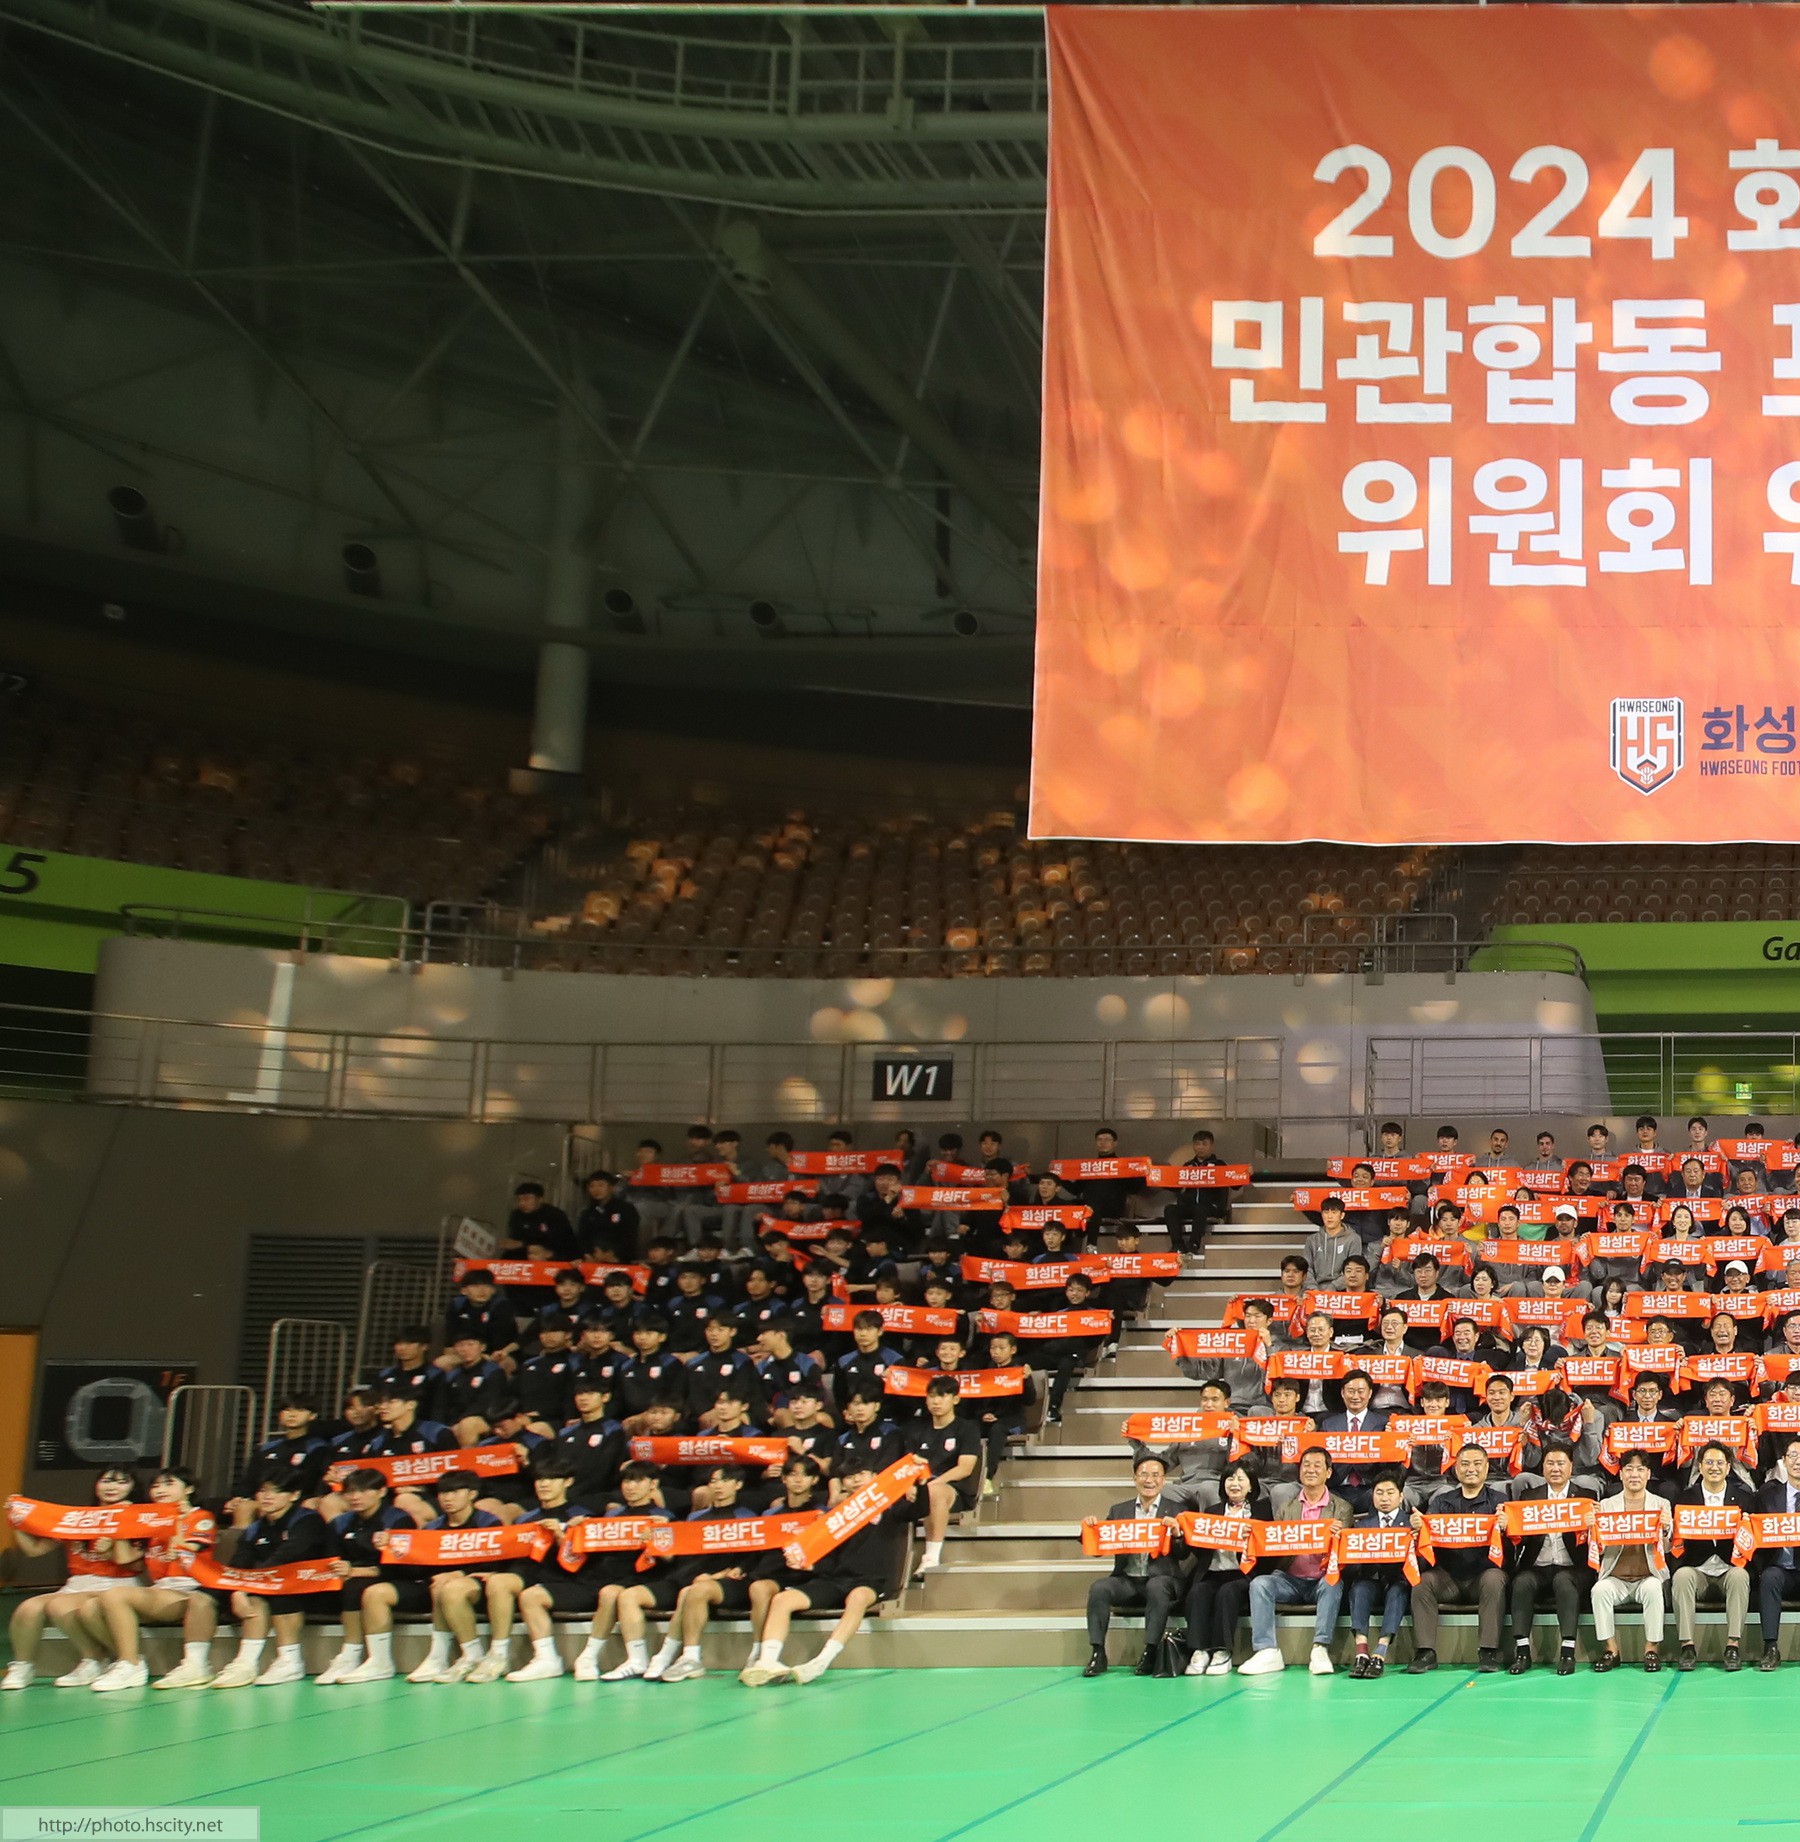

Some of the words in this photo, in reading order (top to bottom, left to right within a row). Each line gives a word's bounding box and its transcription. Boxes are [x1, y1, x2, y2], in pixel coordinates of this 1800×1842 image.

[1312, 146, 1688, 259] 2024
[1210, 297, 1722, 425] 민관합동
[1338, 456, 1713, 587] 위원회
[1619, 700, 1675, 713] HWASEONG
[1701, 760, 1767, 776] HWASEONG
[886, 1065, 939, 1096] W1
[825, 1155, 866, 1167] 화성FC
[1080, 1161, 1118, 1172] 화성FC
[1179, 1169, 1215, 1181] 화성FC
[932, 1190, 970, 1202] 화성FC
[1456, 1187, 1496, 1199] 화성FC
[1021, 1210, 1062, 1222] 화성FC
[1599, 1235, 1640, 1248] 화성FC
[1713, 1240, 1755, 1252] 화성FC
[1409, 1244, 1451, 1258] 화성FC
[1519, 1244, 1560, 1257] 화성FC
[1658, 1244, 1699, 1258] 화성FC
[1026, 1265, 1070, 1280] 화성FC
[1315, 1295, 1361, 1309] 화성FC
[1519, 1301, 1562, 1314] 화성FC
[1642, 1296, 1687, 1308] 화성FC
[1019, 1315, 1067, 1328] 화성FC
[1197, 1333, 1245, 1348] 화성FC
[1284, 1354, 1333, 1368] 화성FC
[1628, 1348, 1676, 1363] 화성FC
[1358, 1359, 1405, 1373] 화성FC
[1422, 1356, 1469, 1376] 화성FC
[1567, 1361, 1614, 1374] 화성FC
[1698, 1357, 1747, 1371] 화성FC
[1151, 1417, 1202, 1432] 화성FC
[1394, 1419, 1448, 1434] 화성FC
[1688, 1420, 1740, 1436] 화성FC
[1462, 1430, 1513, 1446] 화성FC
[1614, 1426, 1665, 1441] 화성FC
[678, 1441, 733, 1456] 화성FC
[1326, 1435, 1380, 1450] 화성FC
[392, 1455, 458, 1476] 화성FC
[825, 1483, 884, 1531] 화성FC
[1522, 1503, 1581, 1522] 화성FC
[1429, 1517, 1488, 1534] 화성FC
[1598, 1513, 1657, 1531] 화성FC
[1679, 1509, 1738, 1527] 화성FC
[585, 1520, 646, 1540] 화성FC
[703, 1521, 765, 1541] 화성FC
[1099, 1523, 1160, 1539] 화성FC
[1266, 1523, 1324, 1542] 화성FC
[440, 1531, 502, 1551] 화성FC
[1348, 1532, 1405, 1551] 화성FC
